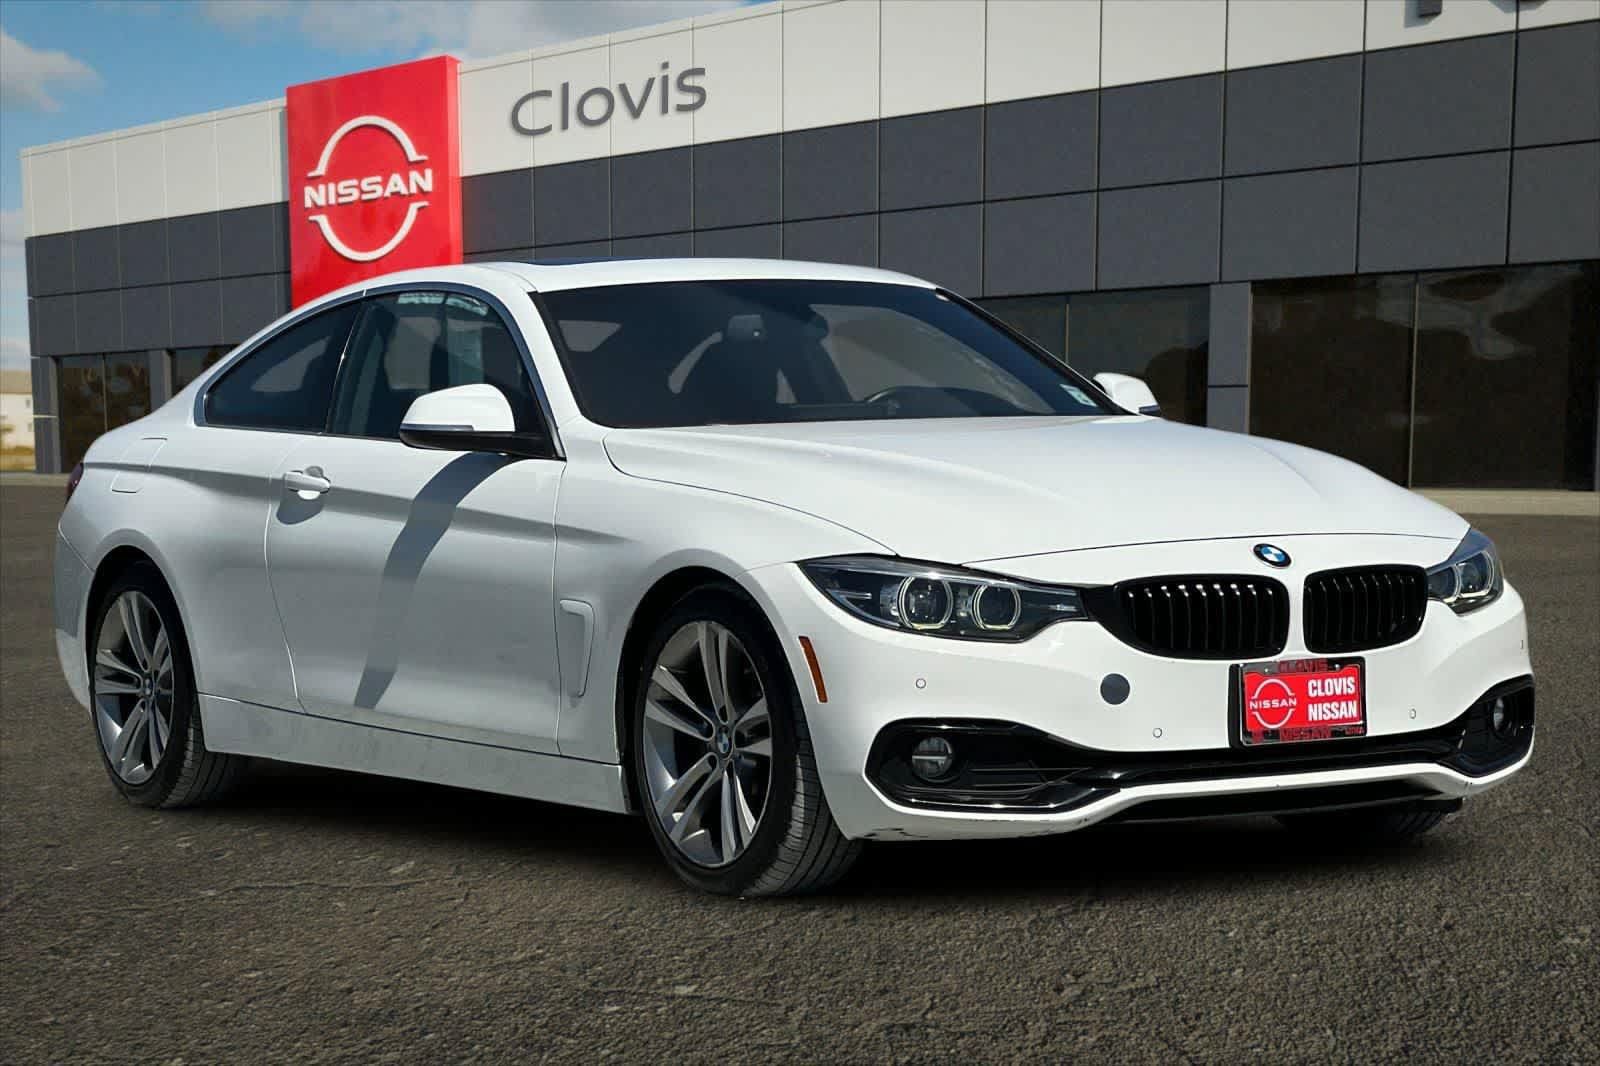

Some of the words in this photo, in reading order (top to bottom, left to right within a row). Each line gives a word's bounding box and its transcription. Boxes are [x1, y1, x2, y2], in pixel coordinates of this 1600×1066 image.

[511, 62, 707, 136] Clovis
[304, 168, 433, 208] NISSAN
[1308, 677, 1355, 698] CLOVIS
[1250, 697, 1297, 710] NISSAN
[1308, 700, 1357, 721] NISSAN
